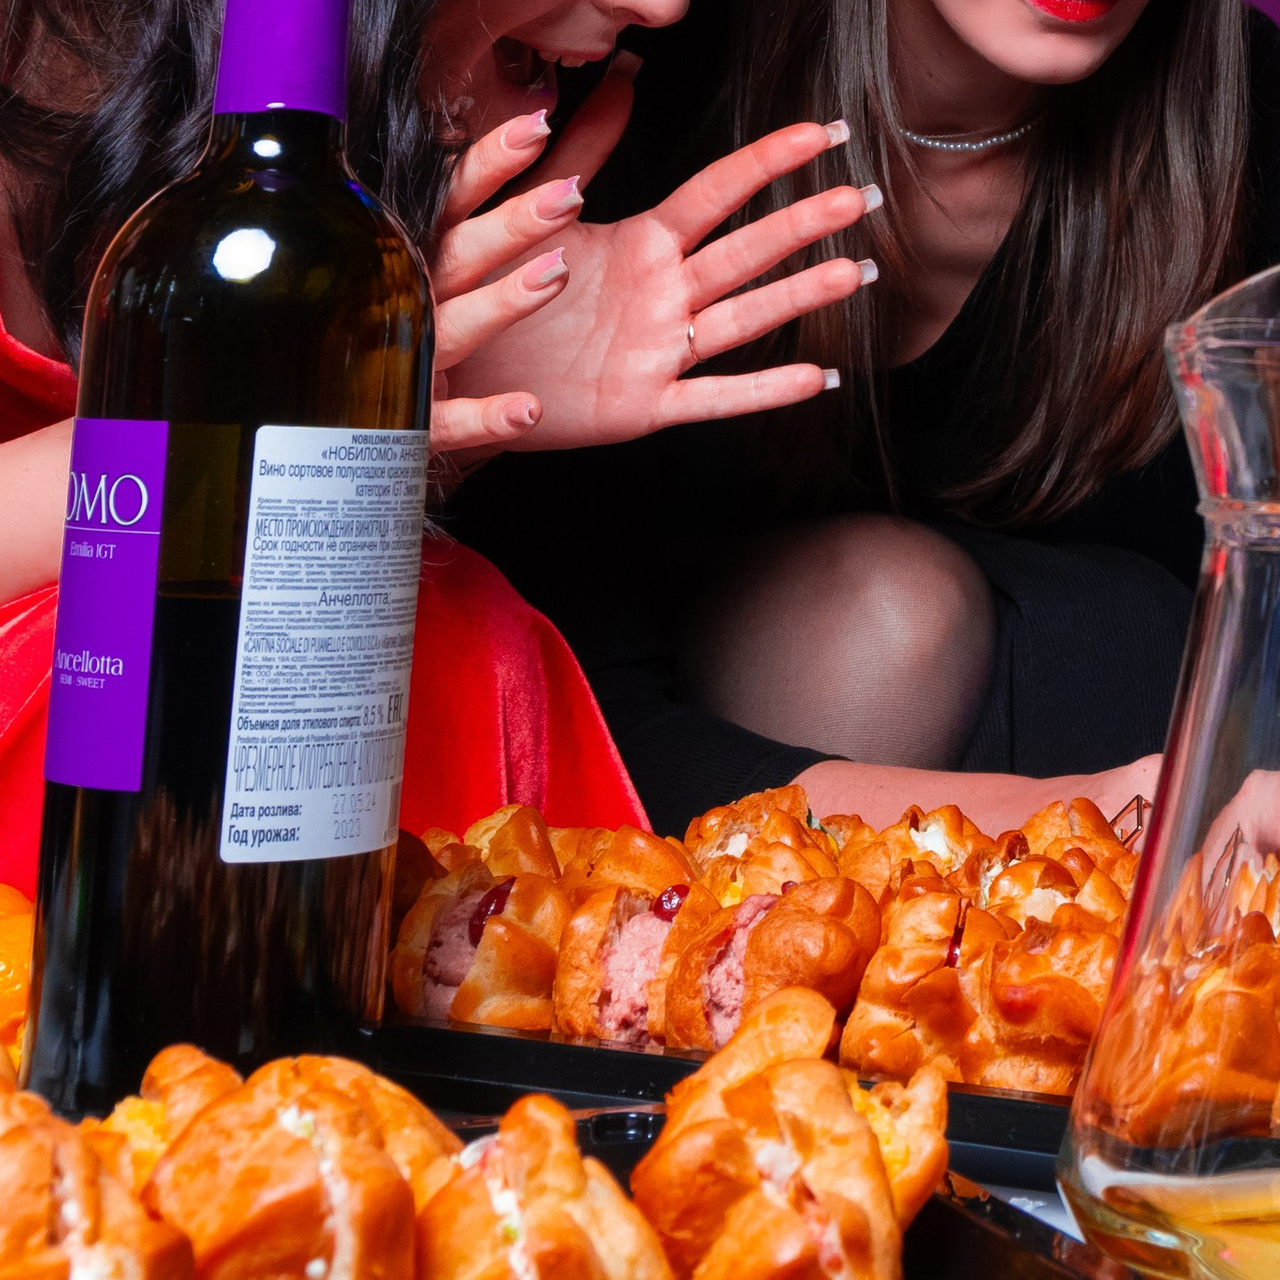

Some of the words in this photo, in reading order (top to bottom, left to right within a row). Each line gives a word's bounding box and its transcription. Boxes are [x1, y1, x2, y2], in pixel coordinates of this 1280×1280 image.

[352, 434, 390, 445] NOBILOMO
[321, 446, 397, 461] «НОБИЛОМО»
[259, 460, 285, 477] Вино
[288, 464, 333, 480] сортовое
[336, 466, 386, 482] полусладкое
[356, 483, 390, 498] категория
[255, 518, 285, 536] МЕСТО
[287, 520, 352, 538] ПРОИСХОЖДЕНИЯ
[96, 544, 116, 558] IGT
[253, 537, 278, 554] Срок
[281, 539, 324, 552] годности
[326, 540, 336, 552] не
[340, 541, 376, 554] ограничен
[276, 638, 302, 653] SOCIALE
[55, 648, 123, 676] Ancellotta
[76, 676, 106, 689] SWEET
[237, 716, 279, 731] Объемная
[280, 718, 300, 732] доля
[302, 717, 338, 730] этилового
[234, 744, 297, 792] ЧРЕЗМЕРНОЕ
[230, 802, 256, 818] Дата
[258, 804, 302, 820] розлива:
[228, 825, 250, 846] Год
[250, 826, 300, 847] урожая:
